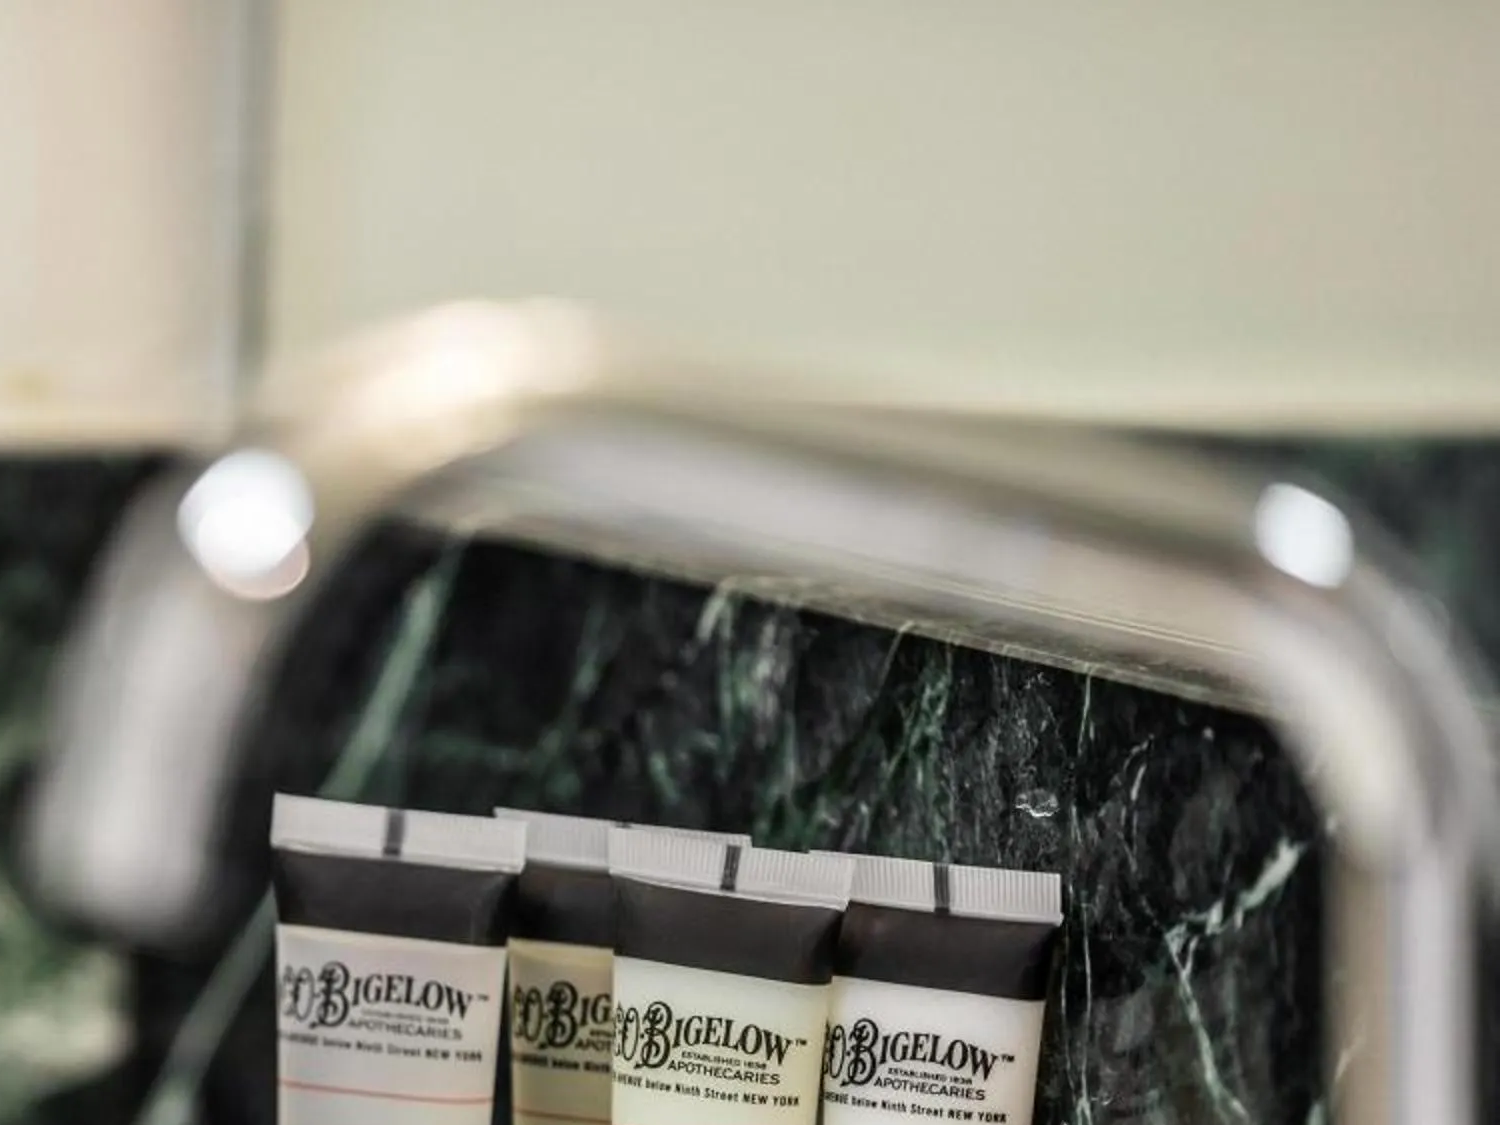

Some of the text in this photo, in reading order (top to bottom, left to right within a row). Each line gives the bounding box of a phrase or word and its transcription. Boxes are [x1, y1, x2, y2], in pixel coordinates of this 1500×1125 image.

[348, 1019, 463, 1041] APOTHECARIES
[681, 1051, 740, 1066] ESTABLISHED
[666, 1059, 781, 1085] APOTHECARIES
[645, 1077, 671, 1093] below
[674, 1082, 701, 1098] Ninth
[704, 1087, 740, 1103] Street
[743, 1094, 768, 1105] NEW
[773, 1096, 800, 1107] YORK
[873, 1076, 986, 1101] APOTHECARIES
[881, 1099, 907, 1114] Ninth
[910, 1103, 944, 1118] Street
[947, 1110, 973, 1121] NEW
[978, 1112, 1007, 1124] YORK
